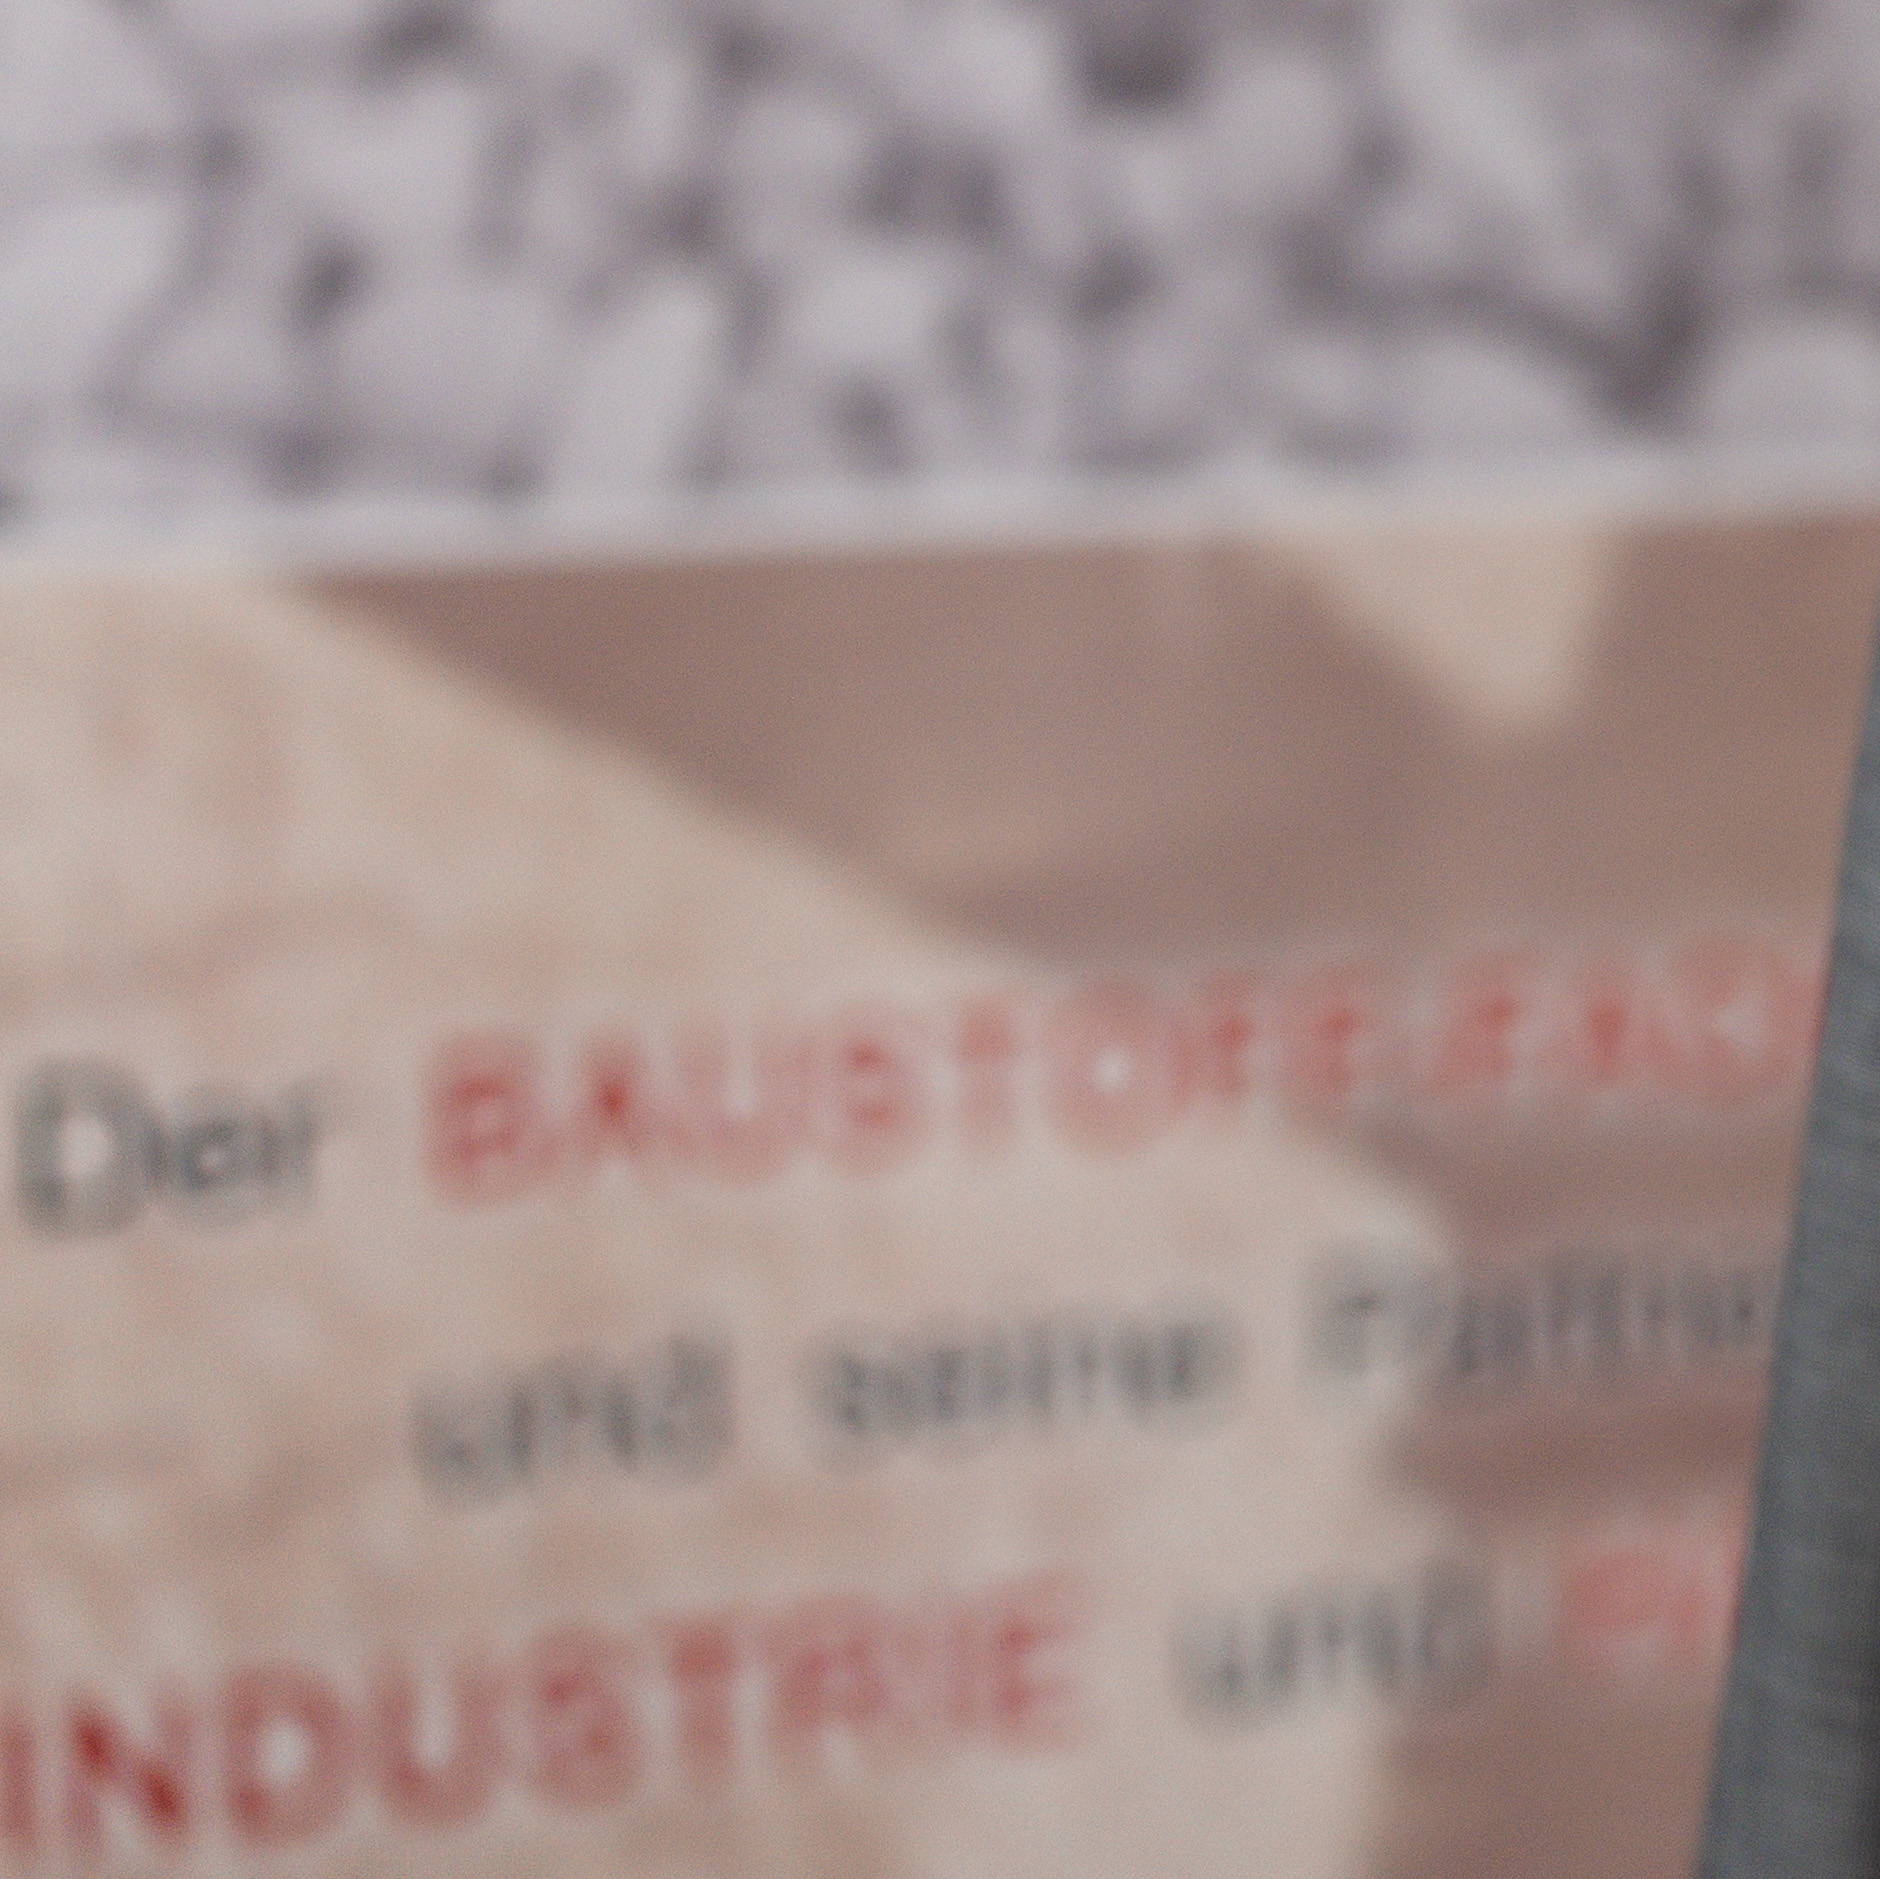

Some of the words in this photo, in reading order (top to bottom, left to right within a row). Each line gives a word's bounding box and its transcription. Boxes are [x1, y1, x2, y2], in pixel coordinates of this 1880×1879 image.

[18, 1065, 325, 1235] Der
[1318, 1245, 1778, 1390] Partne
[0, 1580, 1082, 1865] INDUSTRIE
